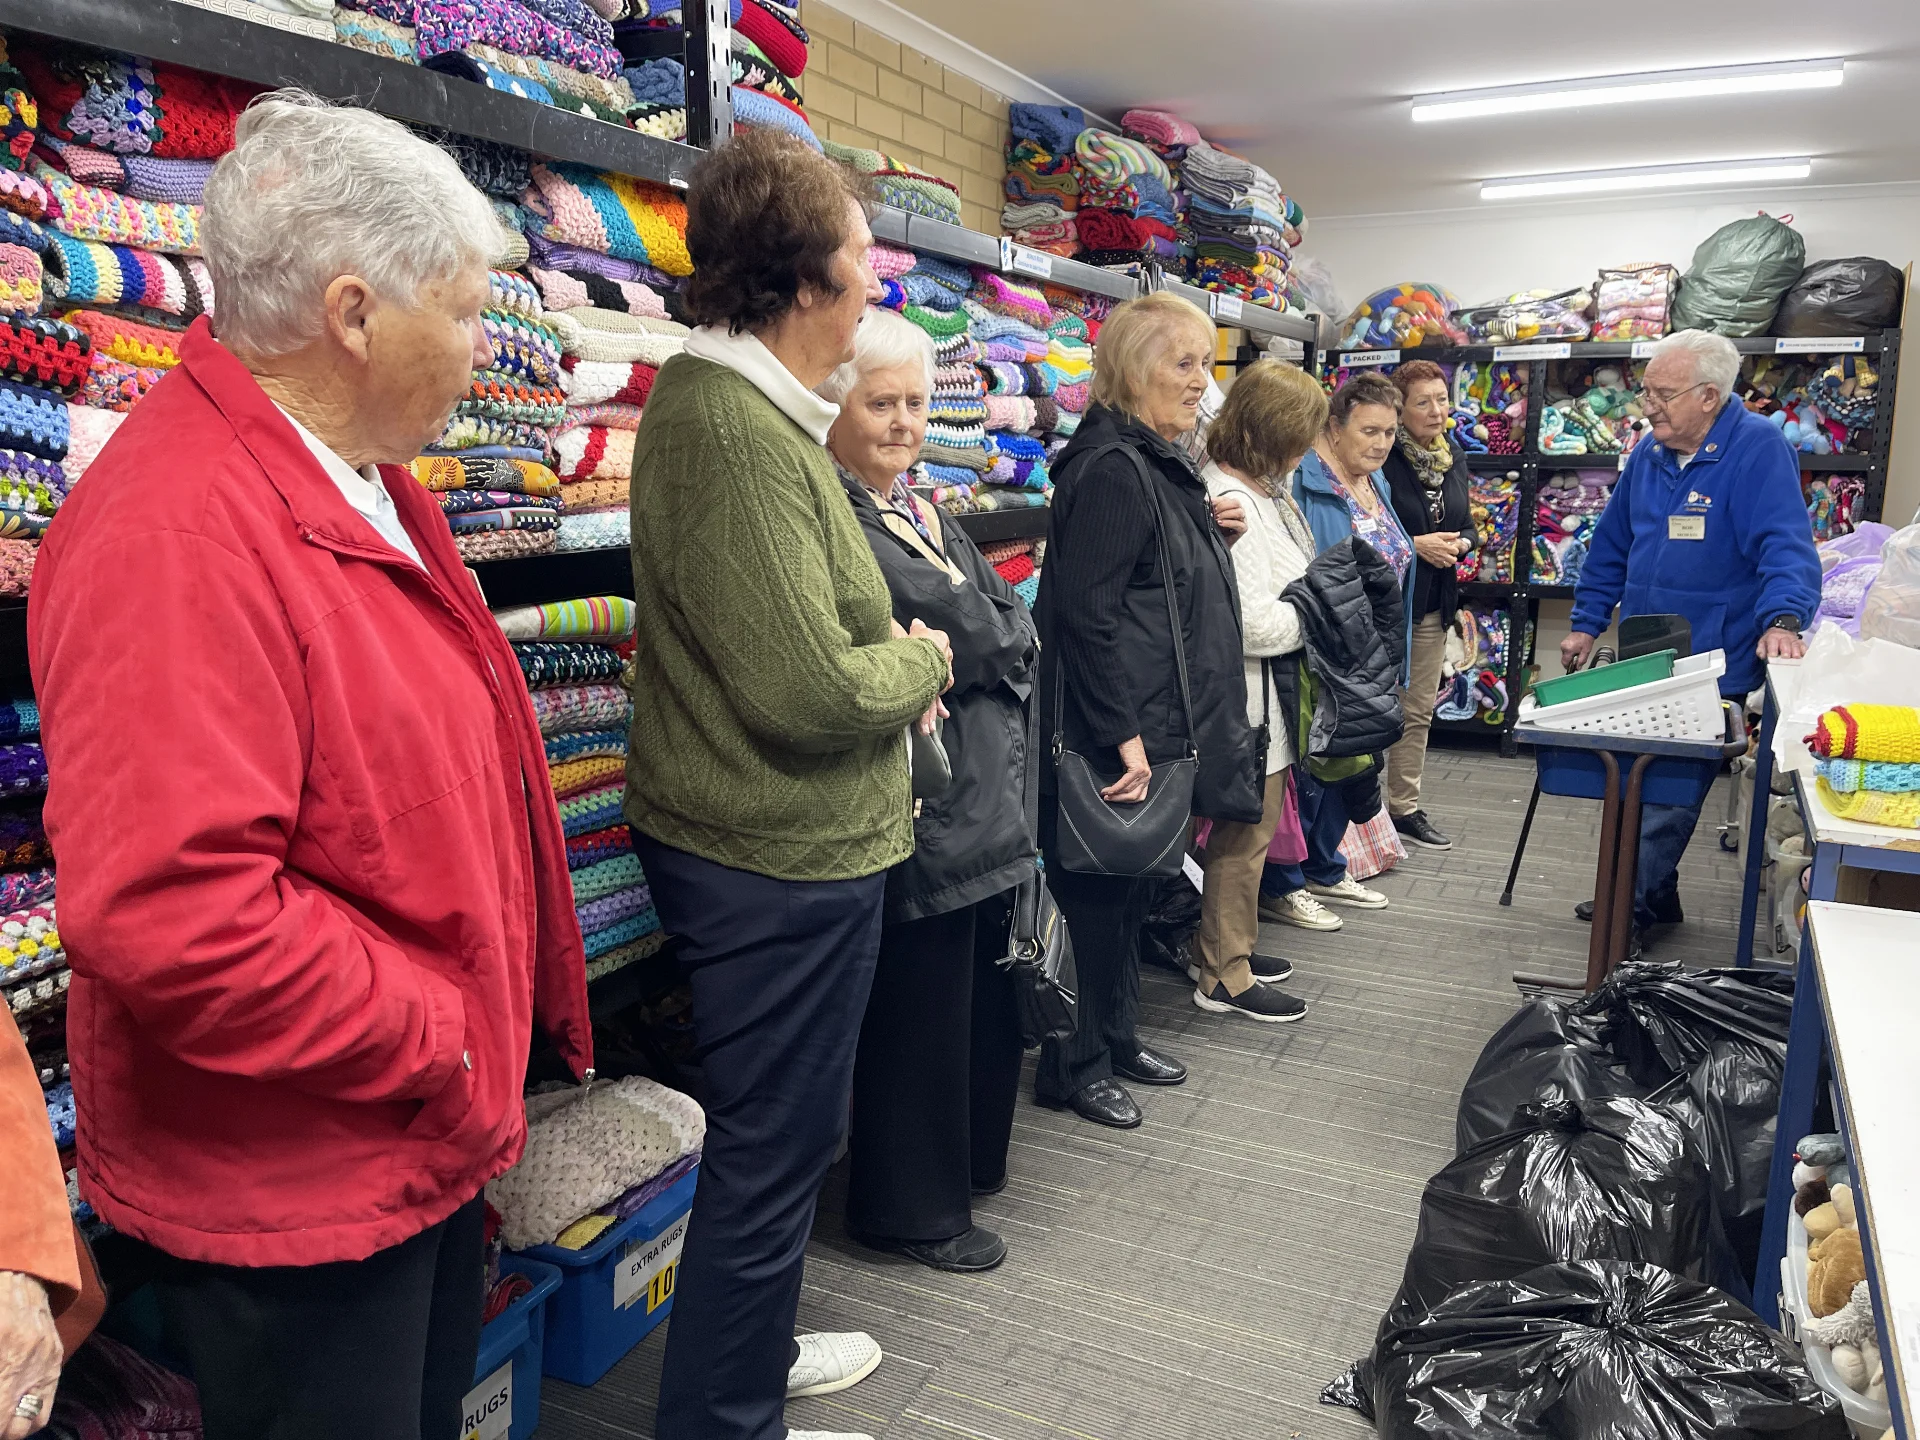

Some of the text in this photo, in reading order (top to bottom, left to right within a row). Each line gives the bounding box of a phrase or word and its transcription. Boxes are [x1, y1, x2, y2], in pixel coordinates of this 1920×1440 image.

[631, 1225, 683, 1277] EXTRA RUGS
[652, 1265, 673, 1306] 10
[465, 1387, 508, 1434] RUGS
